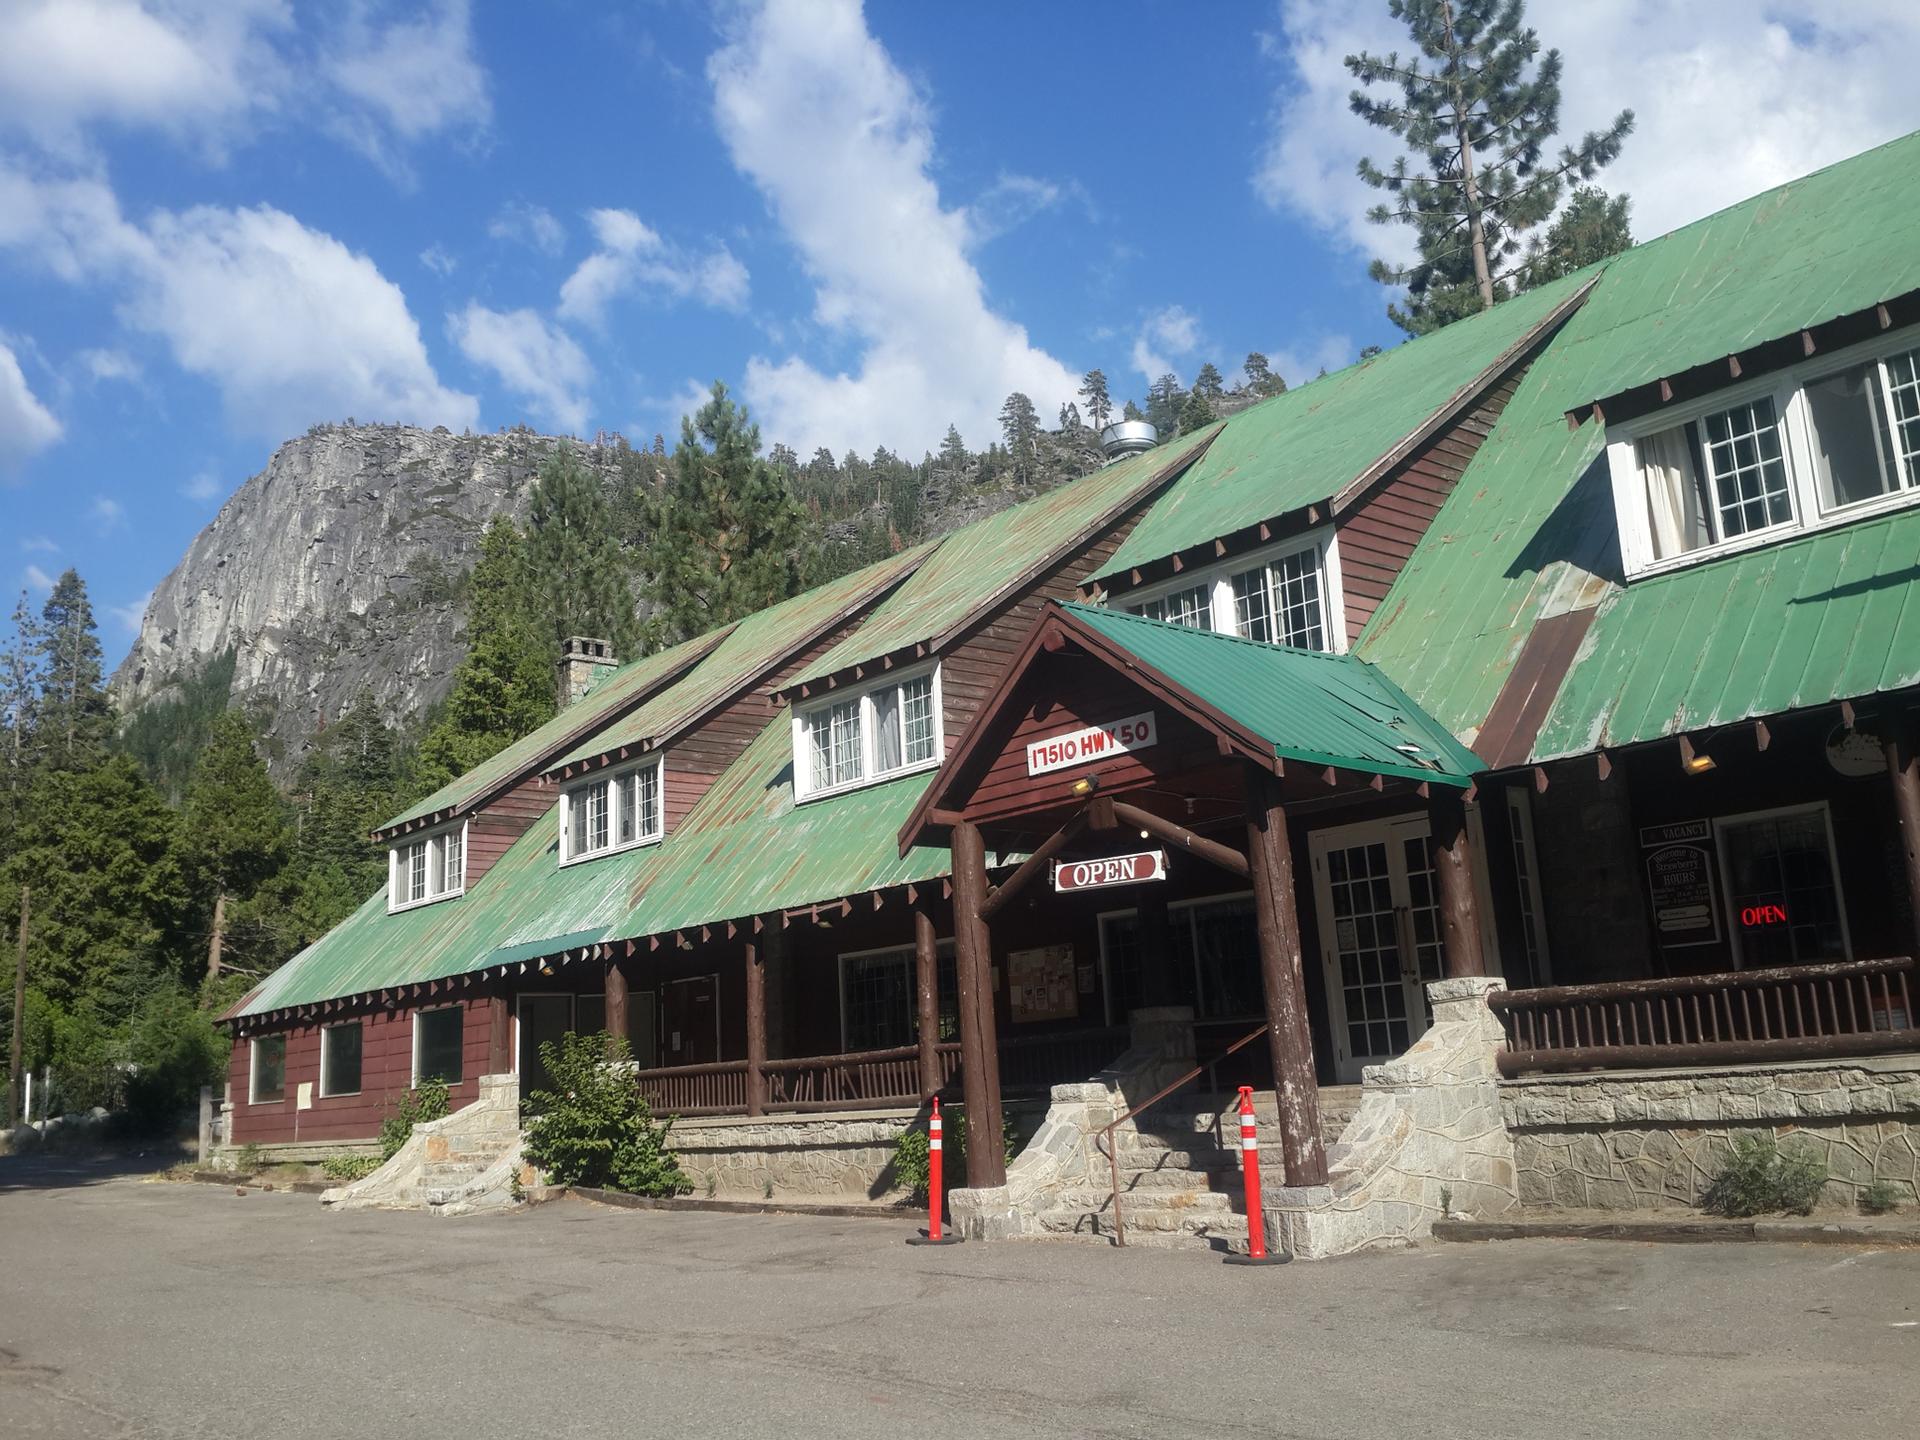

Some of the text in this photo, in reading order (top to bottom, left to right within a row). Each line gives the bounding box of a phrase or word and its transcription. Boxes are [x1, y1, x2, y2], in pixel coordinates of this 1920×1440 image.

[1032, 721, 1149, 769] 17510 HWY 50
[1663, 823, 1704, 840] VACANCY
[1073, 858, 1138, 886] OPEN
[1663, 870, 1697, 886] HOURS
[1742, 904, 1786, 926] OPEN
